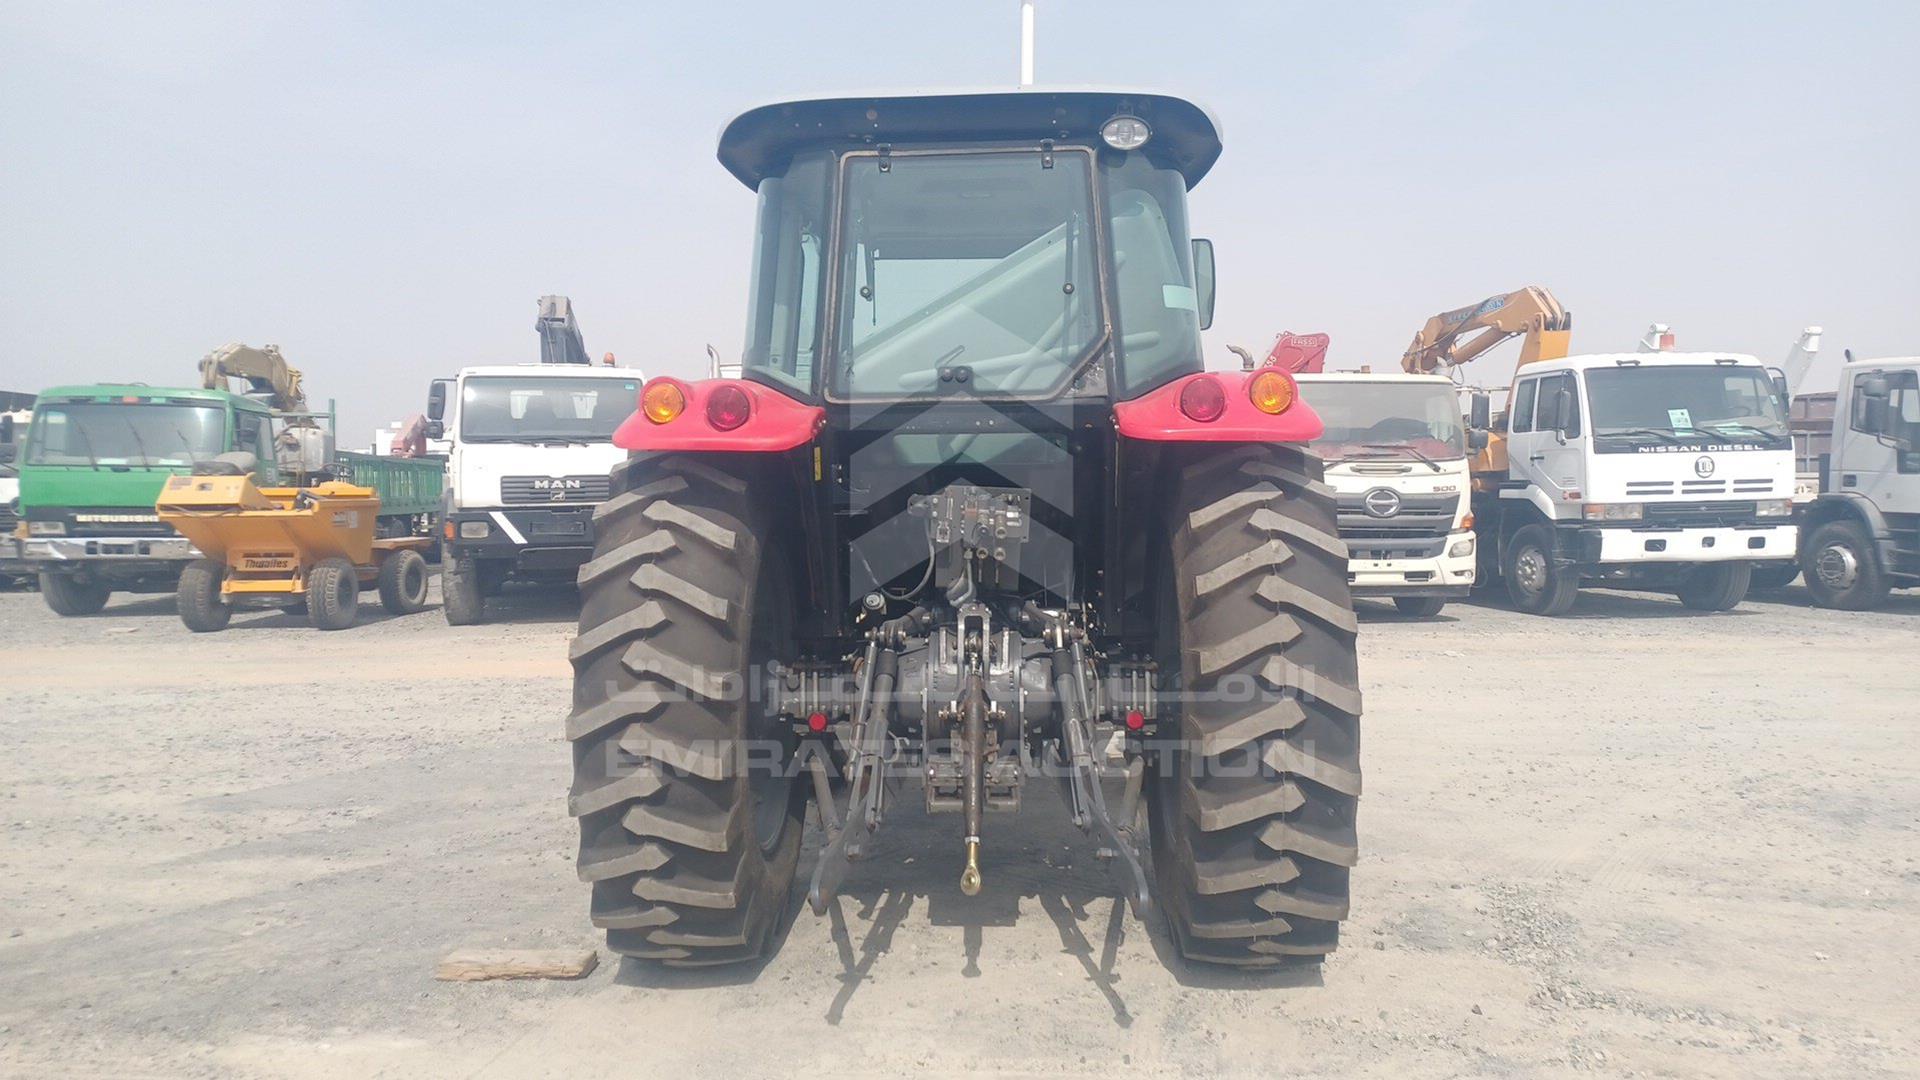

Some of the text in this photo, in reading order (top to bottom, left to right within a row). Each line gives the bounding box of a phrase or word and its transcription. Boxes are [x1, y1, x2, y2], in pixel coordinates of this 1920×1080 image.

[1638, 444, 1763, 453] NISSAN DIESEL
[534, 480, 580, 489] MAN
[245, 559, 288, 569] Thwaites
